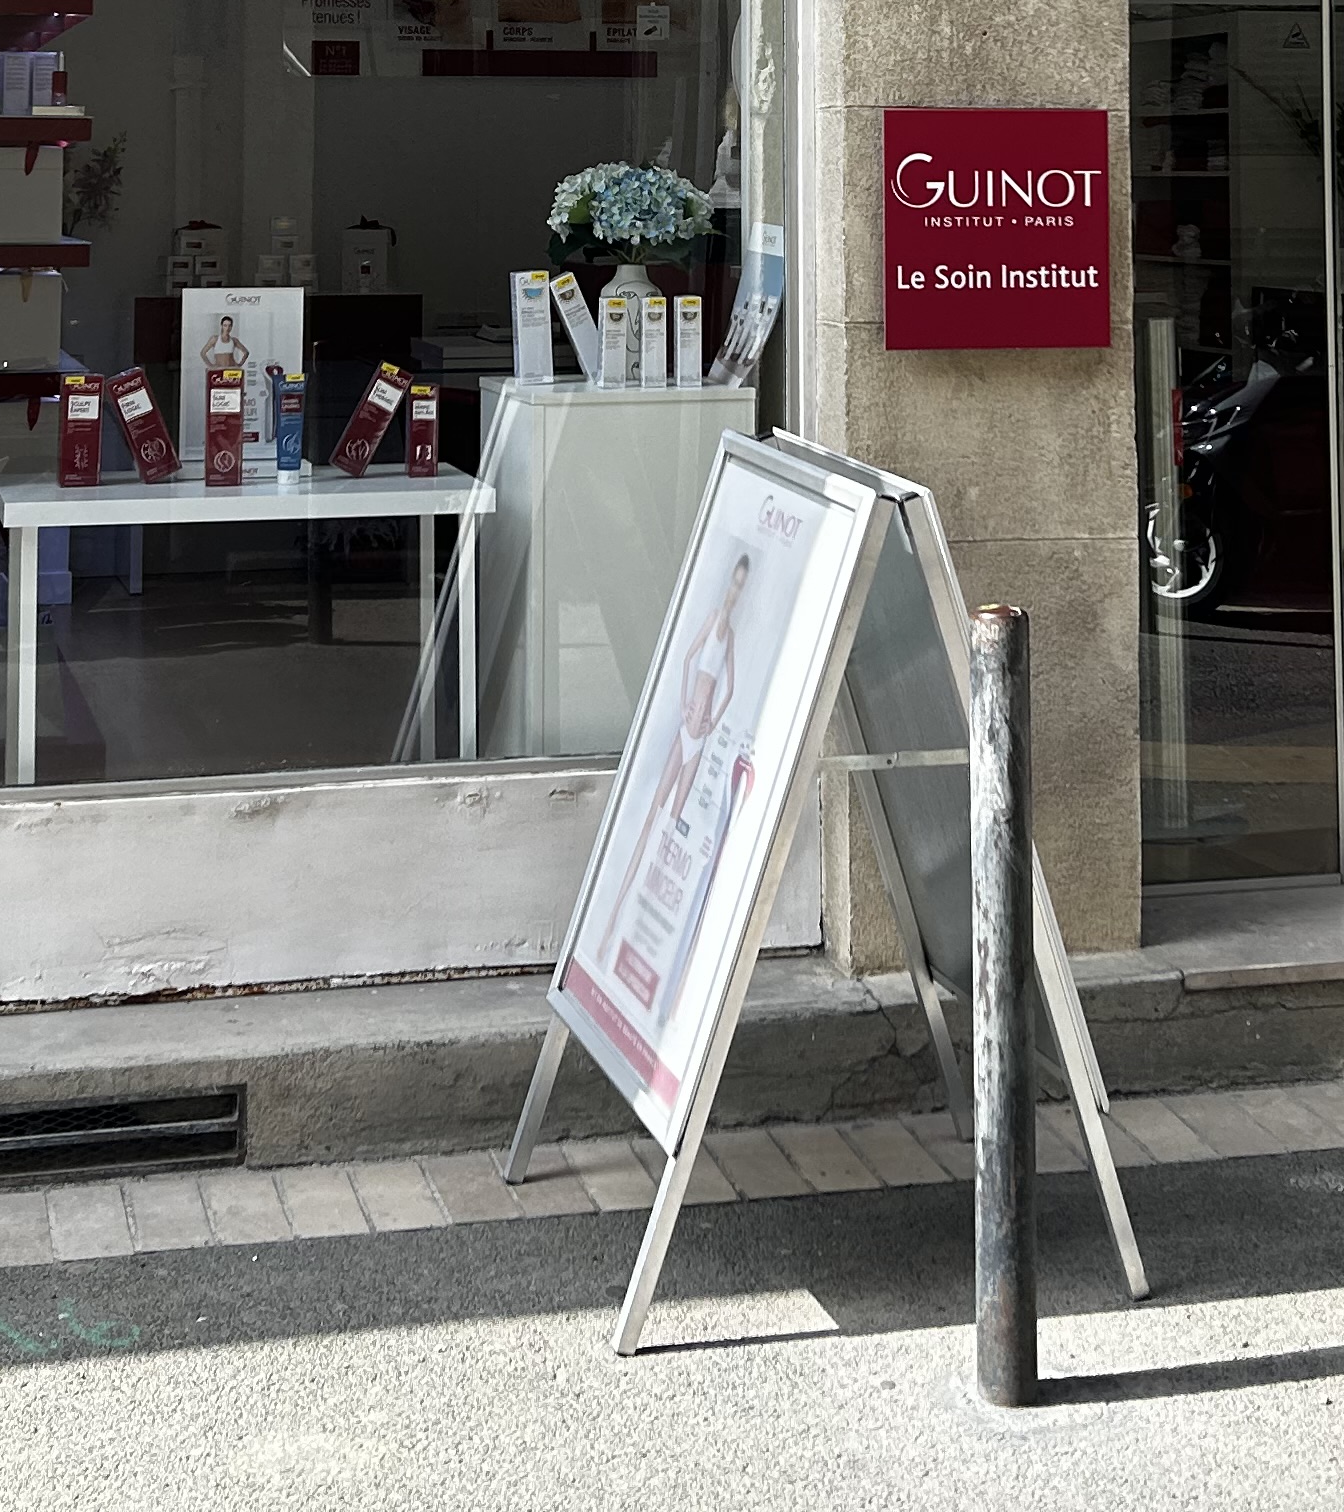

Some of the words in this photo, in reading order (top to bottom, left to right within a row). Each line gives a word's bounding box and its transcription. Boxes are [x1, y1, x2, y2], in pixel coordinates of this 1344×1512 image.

[398, 25, 432, 35] VISAGE
[502, 26, 534, 37] CORPS
[890, 152, 1103, 209] GUINOT
[924, 216, 1005, 227] INSTITUT
[1024, 216, 1075, 227] PARIS
[897, 265, 925, 290] Le
[934, 264, 992, 289] Soin
[1001, 263, 1100, 288] Institut
[225, 293, 263, 306] GUINOT
[758, 495, 803, 540] GUINOT
